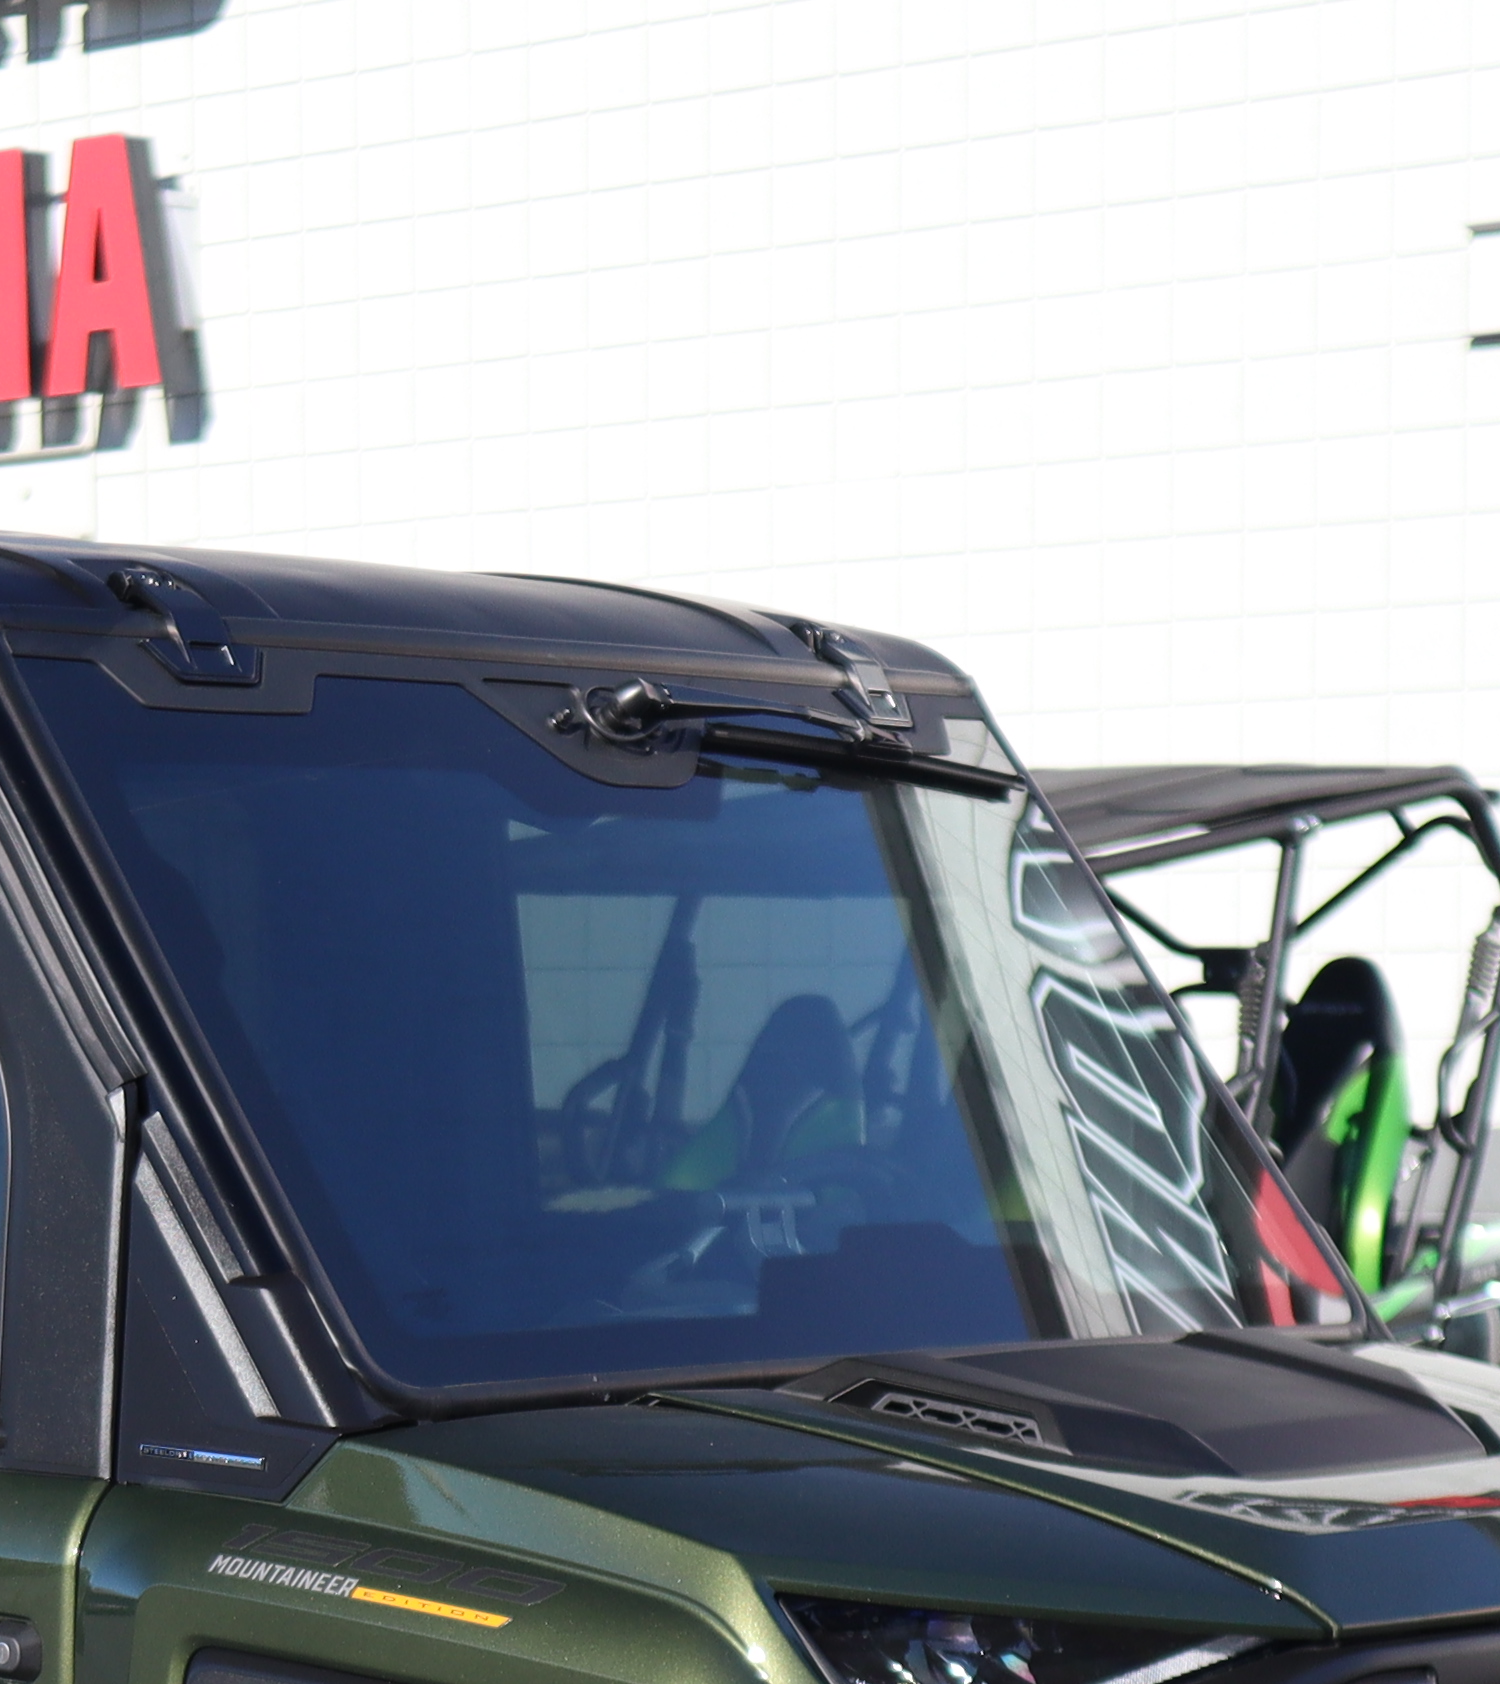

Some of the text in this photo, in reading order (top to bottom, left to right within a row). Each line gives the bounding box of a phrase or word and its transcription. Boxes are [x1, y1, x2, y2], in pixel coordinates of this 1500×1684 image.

[208, 1554, 490, 1622] MOUNTAINEER EDITION
[222, 1522, 567, 1606] 1500
